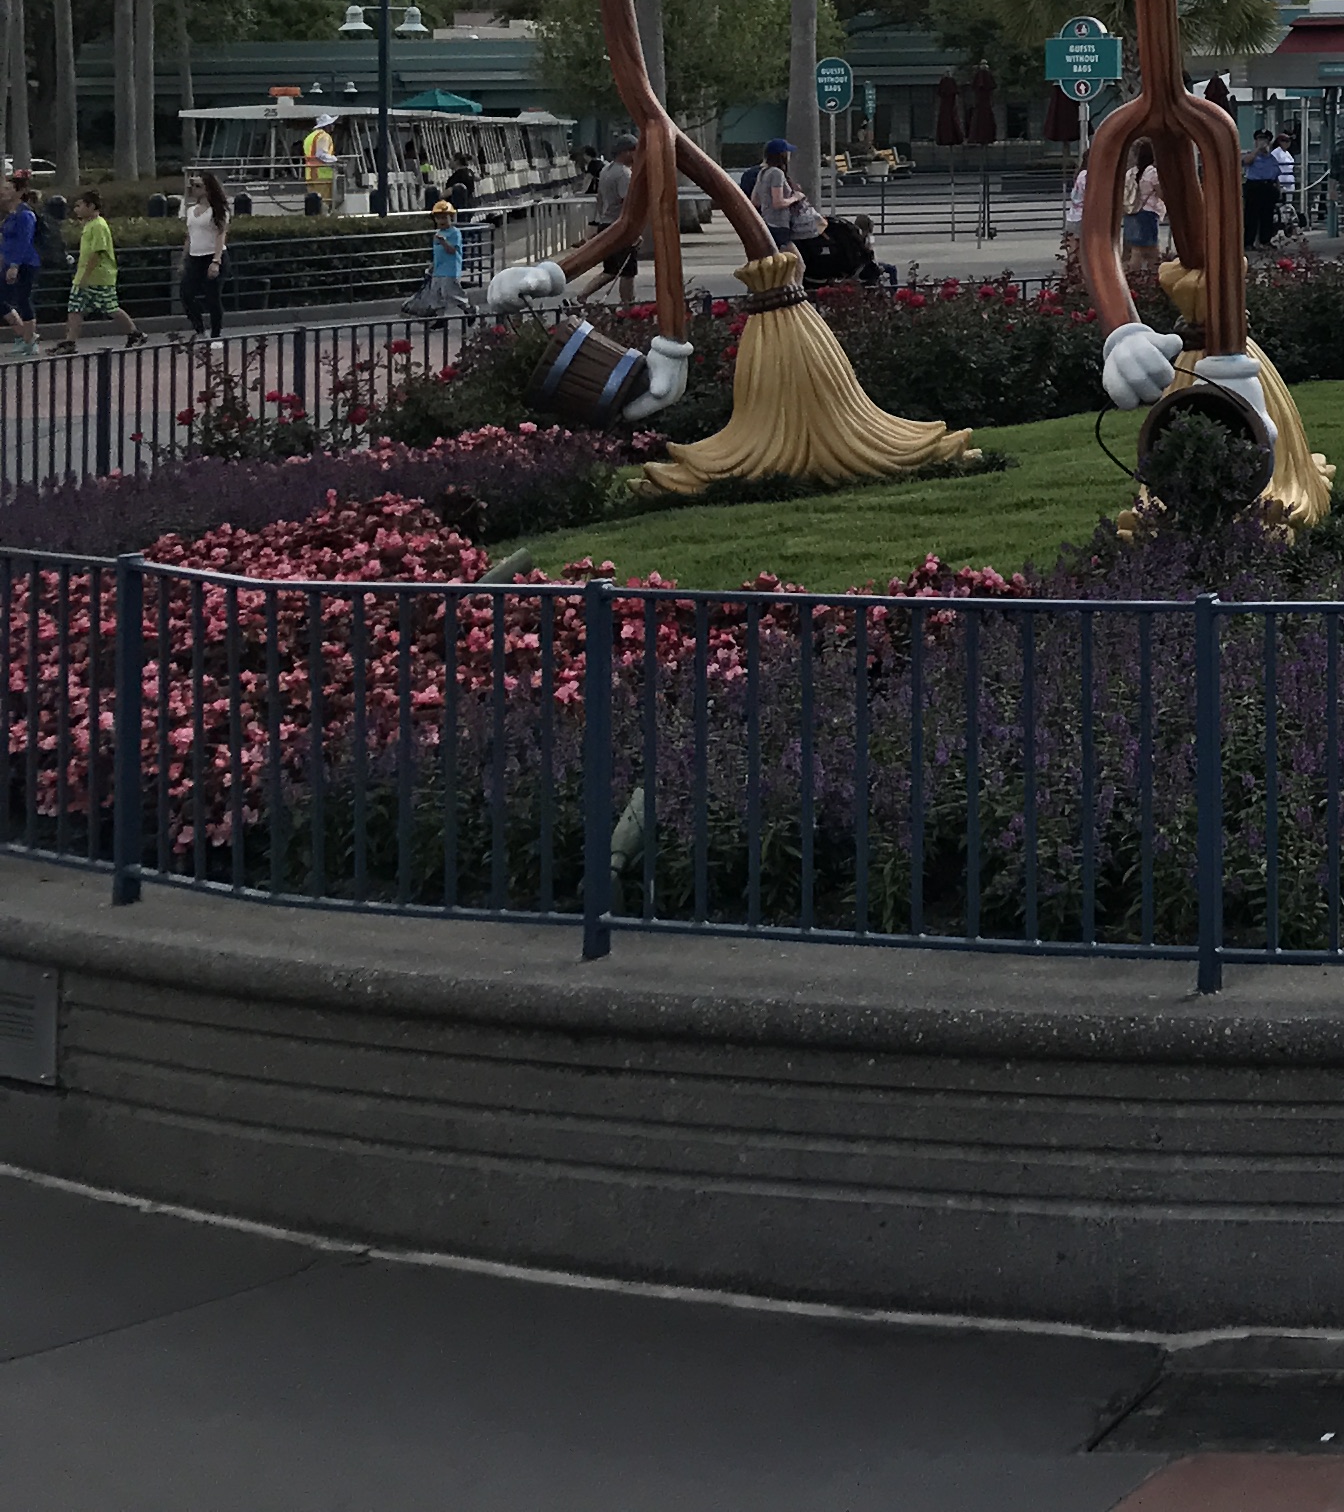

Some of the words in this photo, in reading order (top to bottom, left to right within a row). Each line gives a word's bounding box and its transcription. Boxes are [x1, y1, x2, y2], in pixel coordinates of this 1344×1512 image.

[1068, 44, 1096, 53] GUESTS
[1065, 54, 1099, 63] WITHOUT
[820, 67, 845, 75] GUESTS
[1072, 64, 1092, 73] BAGS
[817, 76, 848, 84] WITHOUT
[263, 108, 278, 117] 25
